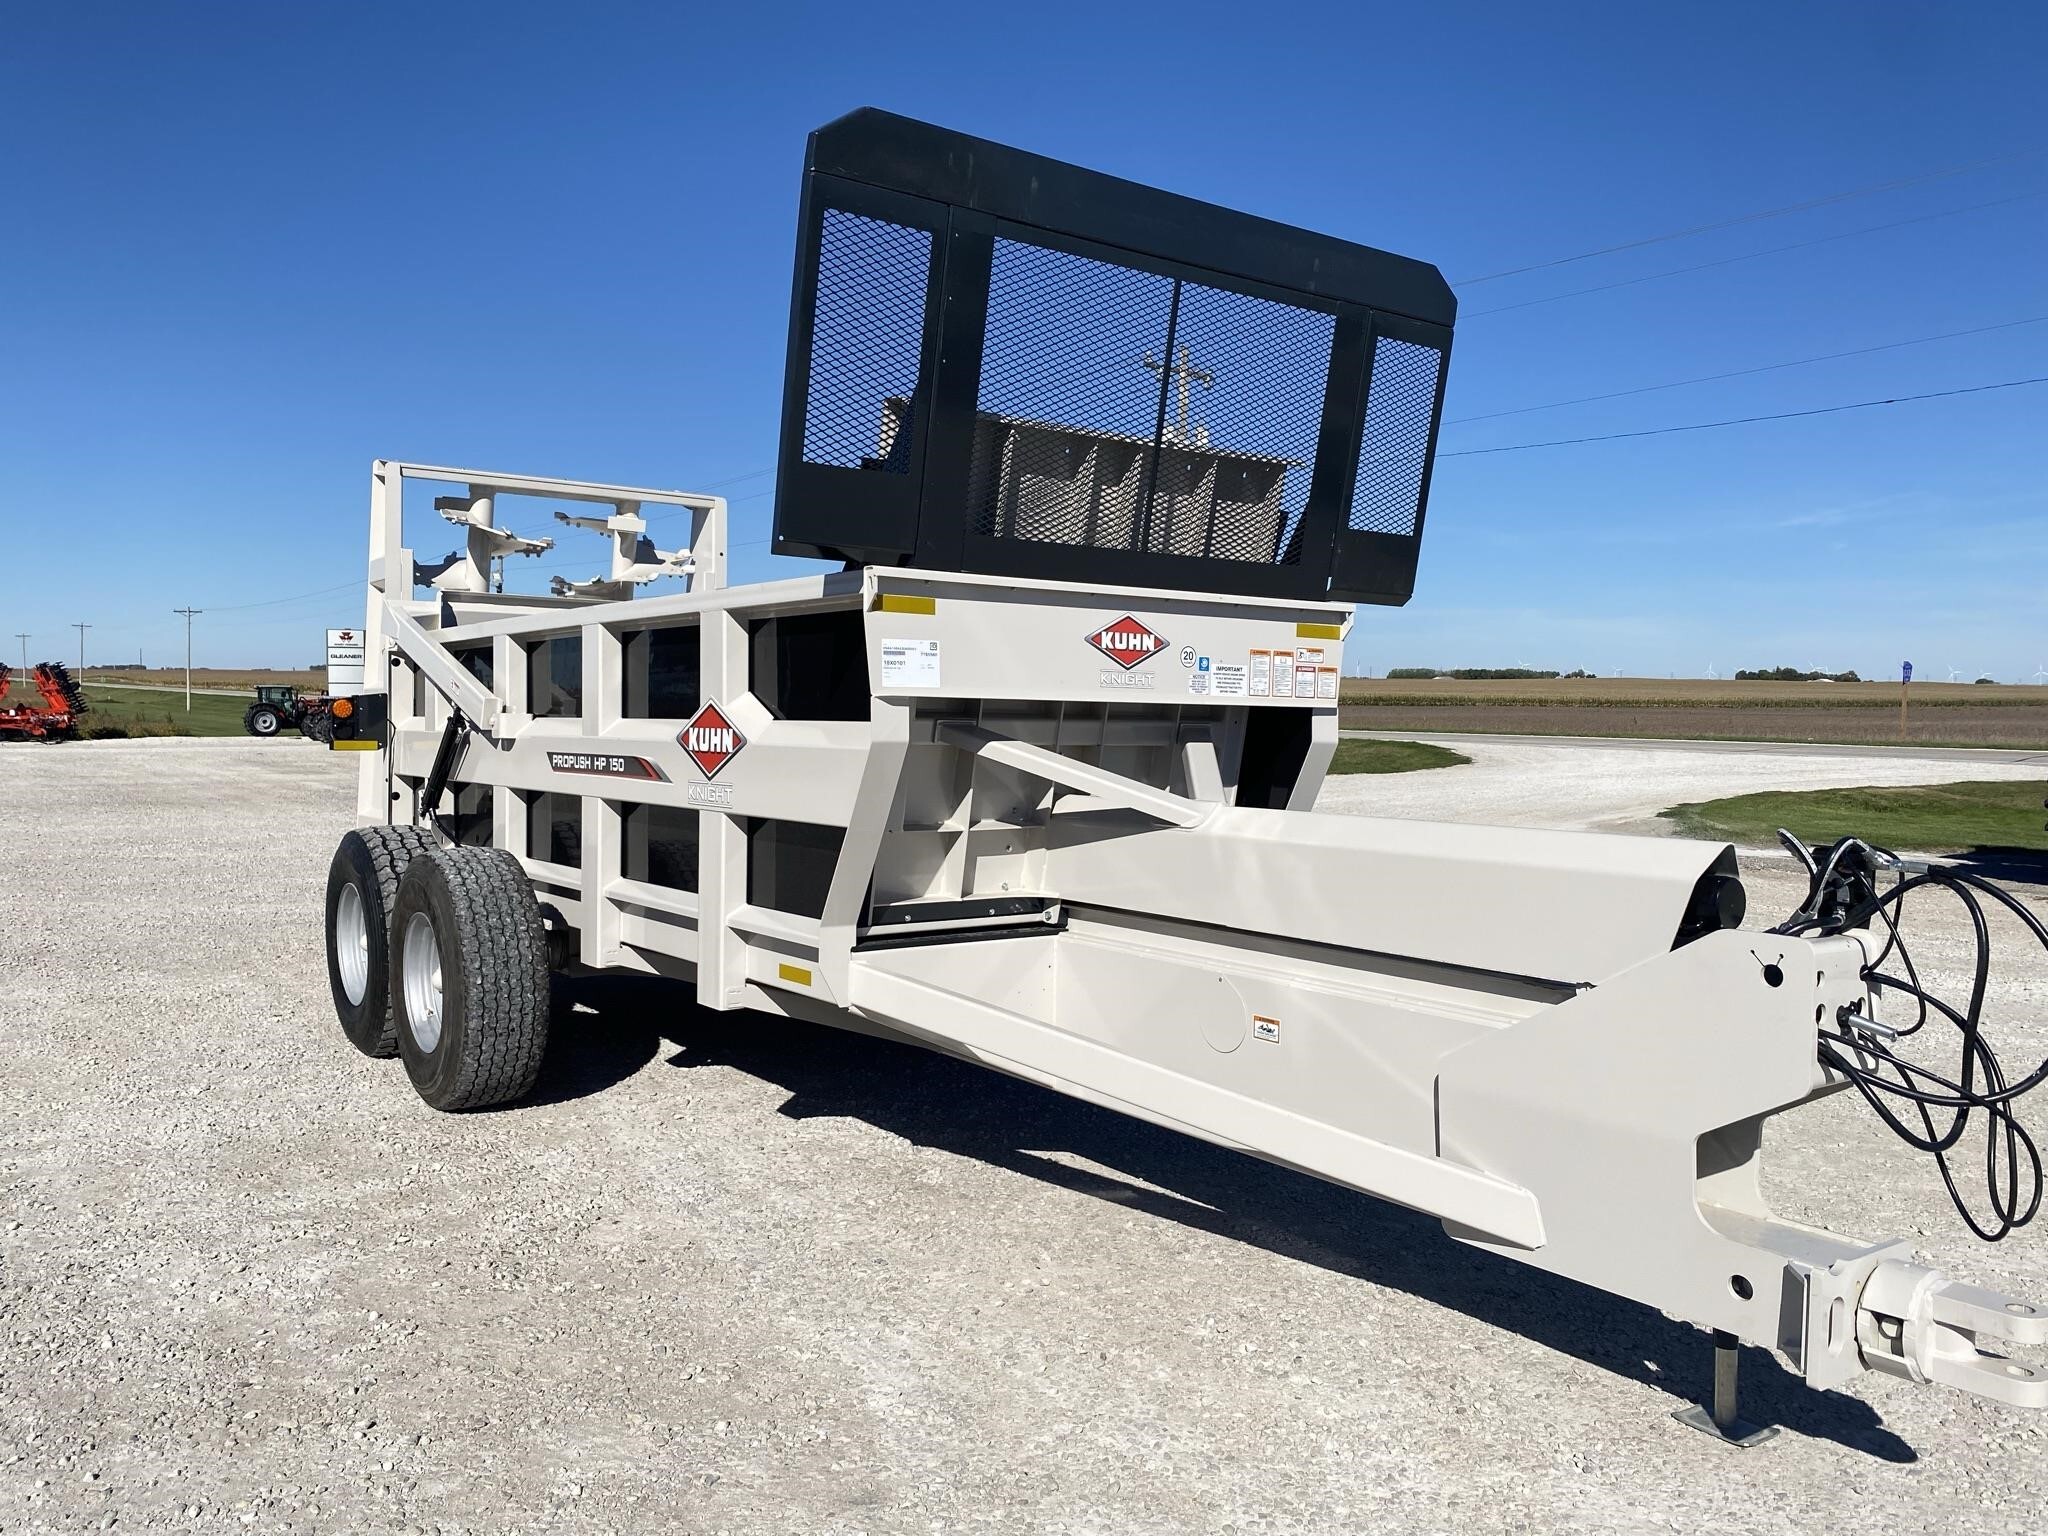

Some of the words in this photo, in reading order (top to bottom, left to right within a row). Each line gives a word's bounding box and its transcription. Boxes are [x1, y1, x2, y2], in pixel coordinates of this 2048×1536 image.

[1101, 631, 1155, 652] KUHN
[1183, 650, 1194, 661] 20
[1100, 672, 1154, 686] KNIGHT
[688, 727, 734, 753] KUHN
[552, 754, 591, 769] PROPUSH
[594, 756, 606, 771] HP
[609, 757, 625, 772] 150
[688, 785, 732, 804] KNIGHT
